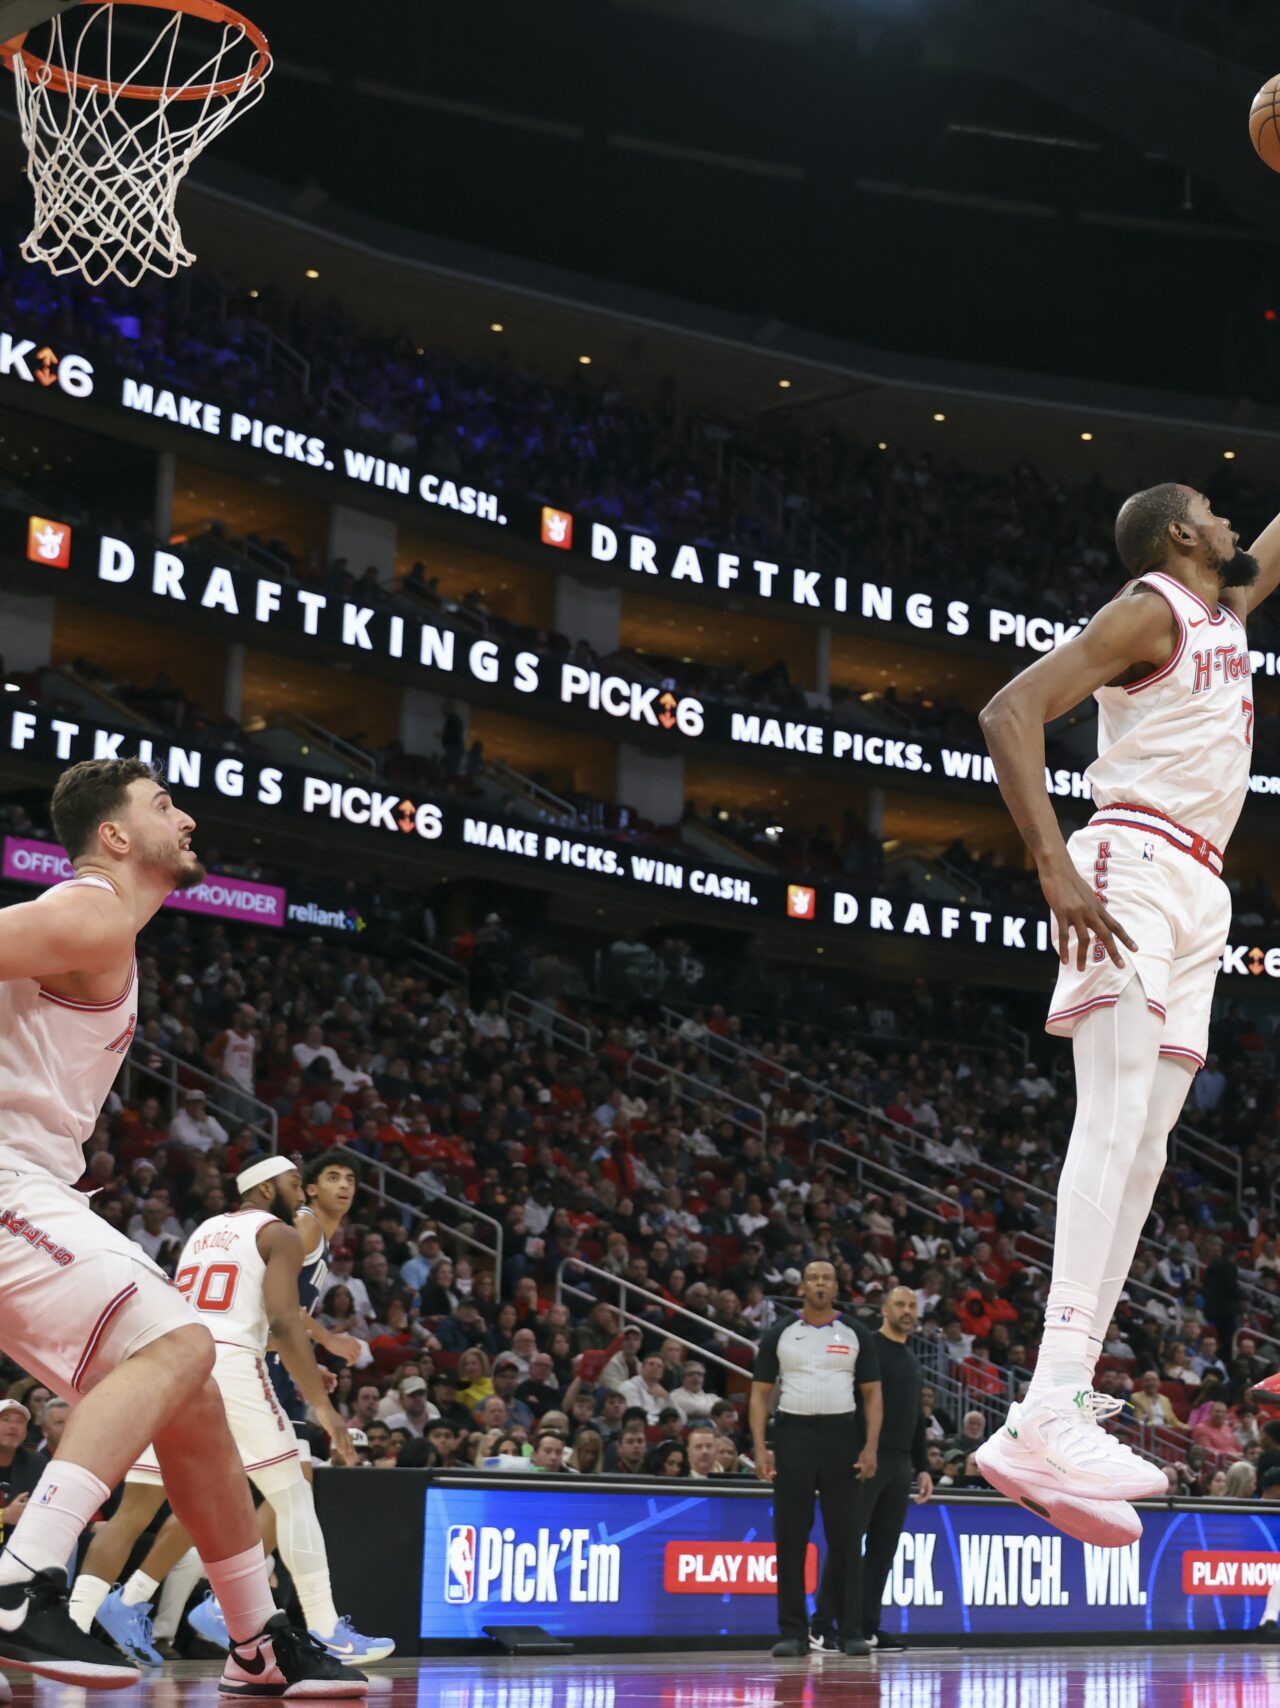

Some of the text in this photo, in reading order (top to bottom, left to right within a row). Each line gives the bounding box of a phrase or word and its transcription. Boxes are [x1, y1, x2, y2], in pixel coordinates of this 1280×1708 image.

[122, 379, 221, 435] MAKE
[230, 412, 335, 471] PICKS.
[343, 448, 411, 495] WIN
[419, 474, 508, 525] CASH.
[591, 522, 970, 636] DRAFTKINGS
[98, 535, 540, 694] DRAFTKINGS
[731, 712, 824, 755] MAKE
[833, 730, 932, 773] PICKS.
[1241, 695, 1254, 750] 7
[11, 847, 75, 879] OFFIC
[185, 883, 278, 916] PROVIDER
[463, 818, 539, 857] MAKE
[544, 836, 625, 876] PICKS.
[630, 855, 684, 889] WIN
[689, 870, 759, 906] CASH.
[288, 902, 347, 930] reliant
[833, 891, 1048, 952] DRAFTKI
[0, 1209, 75, 1267] KETS
[174, 1260, 243, 1315] 20
[477, 1526, 620, 1602] Pick'Em
[678, 1554, 778, 1582] PLAY NO
[959, 1534, 1069, 1606] WATCH.
[1083, 1540, 1148, 1606] WIN.
[1192, 1561, 1238, 1586] PLAY
